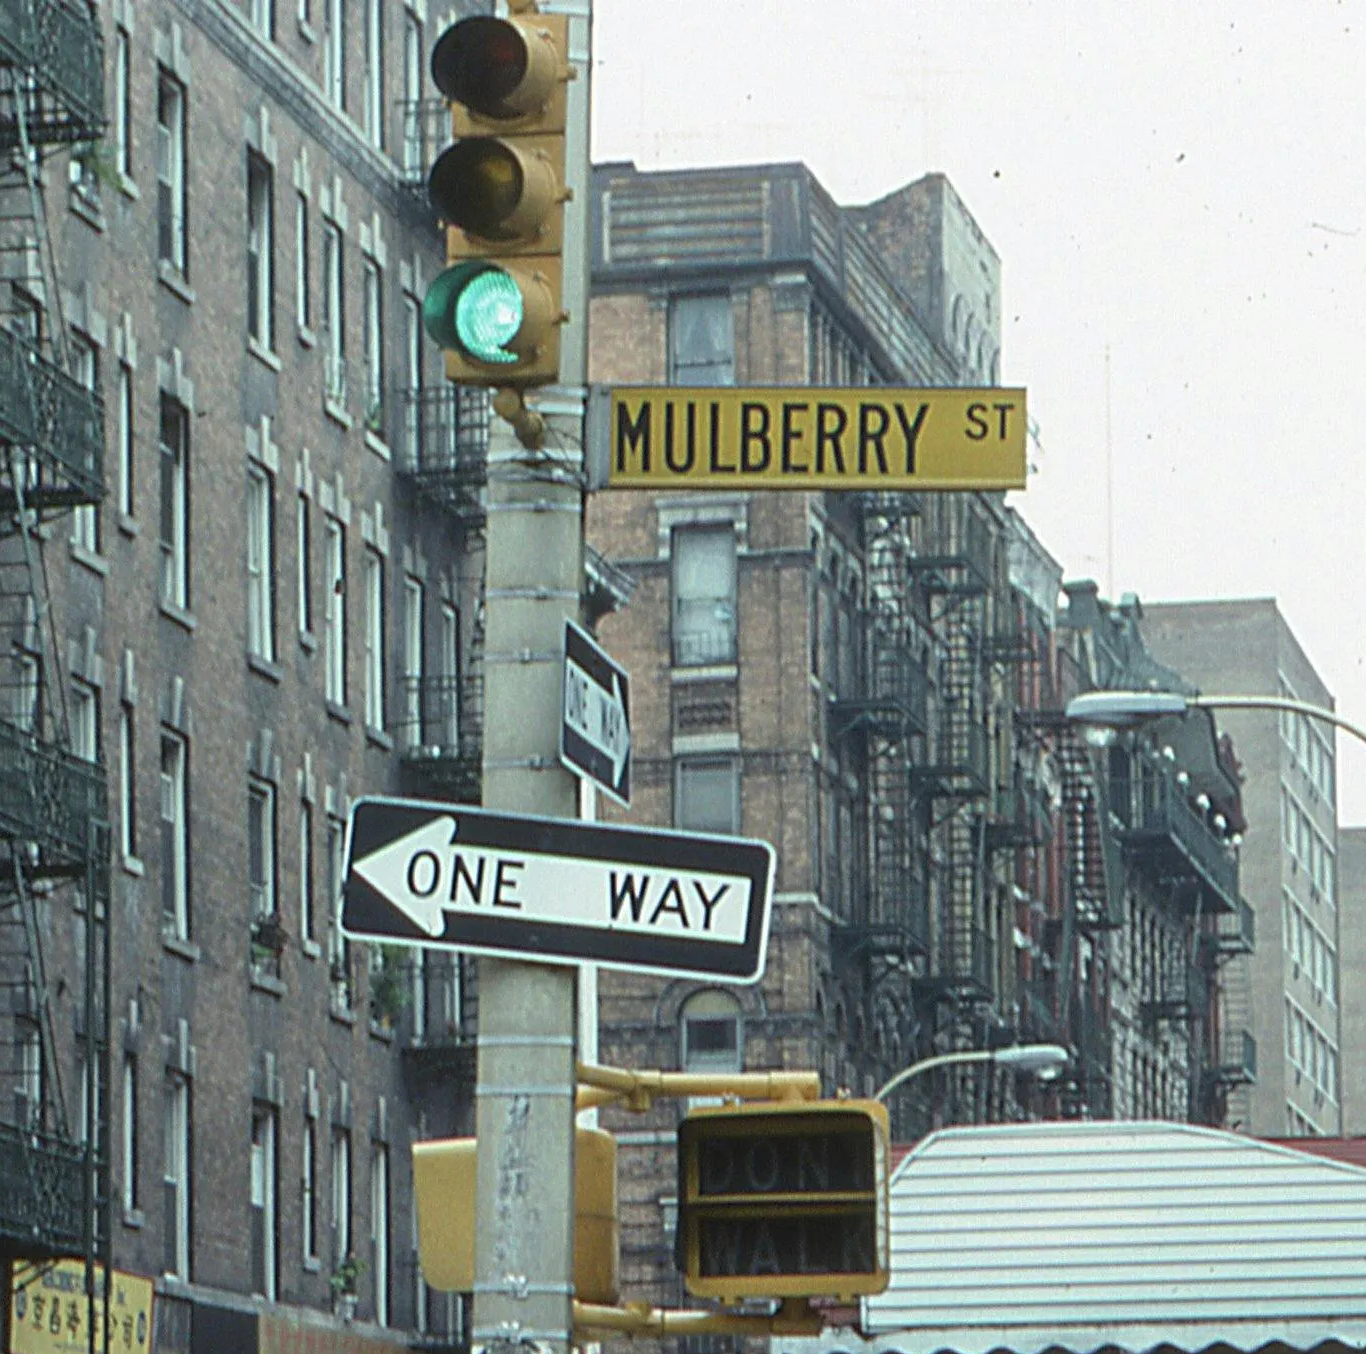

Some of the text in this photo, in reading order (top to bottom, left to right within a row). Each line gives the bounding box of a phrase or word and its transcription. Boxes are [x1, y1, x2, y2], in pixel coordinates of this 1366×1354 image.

[615, 402, 1015, 474] MULBERRY ST
[568, 667, 622, 755] ONE WAY
[406, 850, 731, 931] ONE WAY
